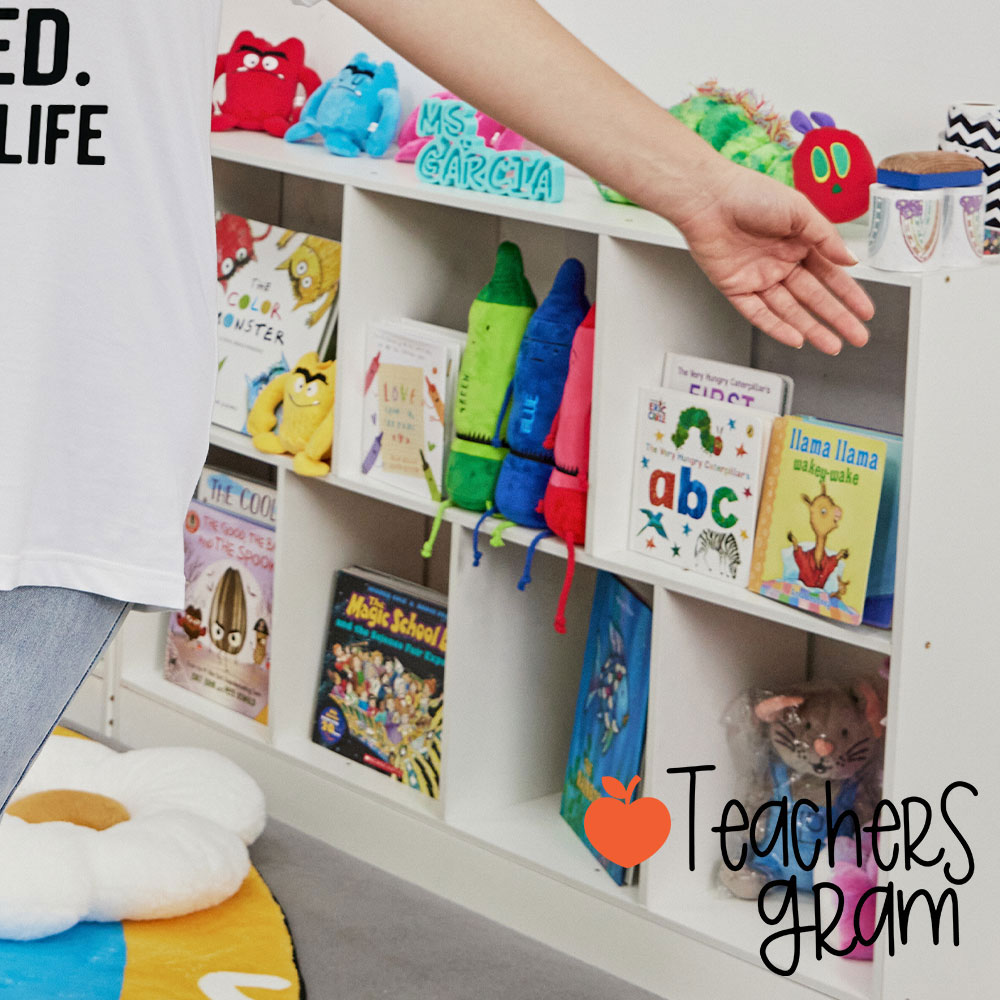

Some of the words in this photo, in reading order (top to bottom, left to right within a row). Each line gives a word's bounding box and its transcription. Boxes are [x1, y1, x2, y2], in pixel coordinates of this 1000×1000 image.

[418, 100, 466, 137] MS
[418, 144, 554, 200] GARCIA
[252, 278, 271, 291] THE
[227, 291, 281, 320] COLOR
[789, 428, 831, 458] llama
[835, 439, 879, 470] llama
[793, 458, 859, 486] wakey-wake
[212, 479, 232, 505] THE
[649, 466, 738, 528] abc
[346, 593, 390, 628] Magic
[390, 608, 441, 647] School
